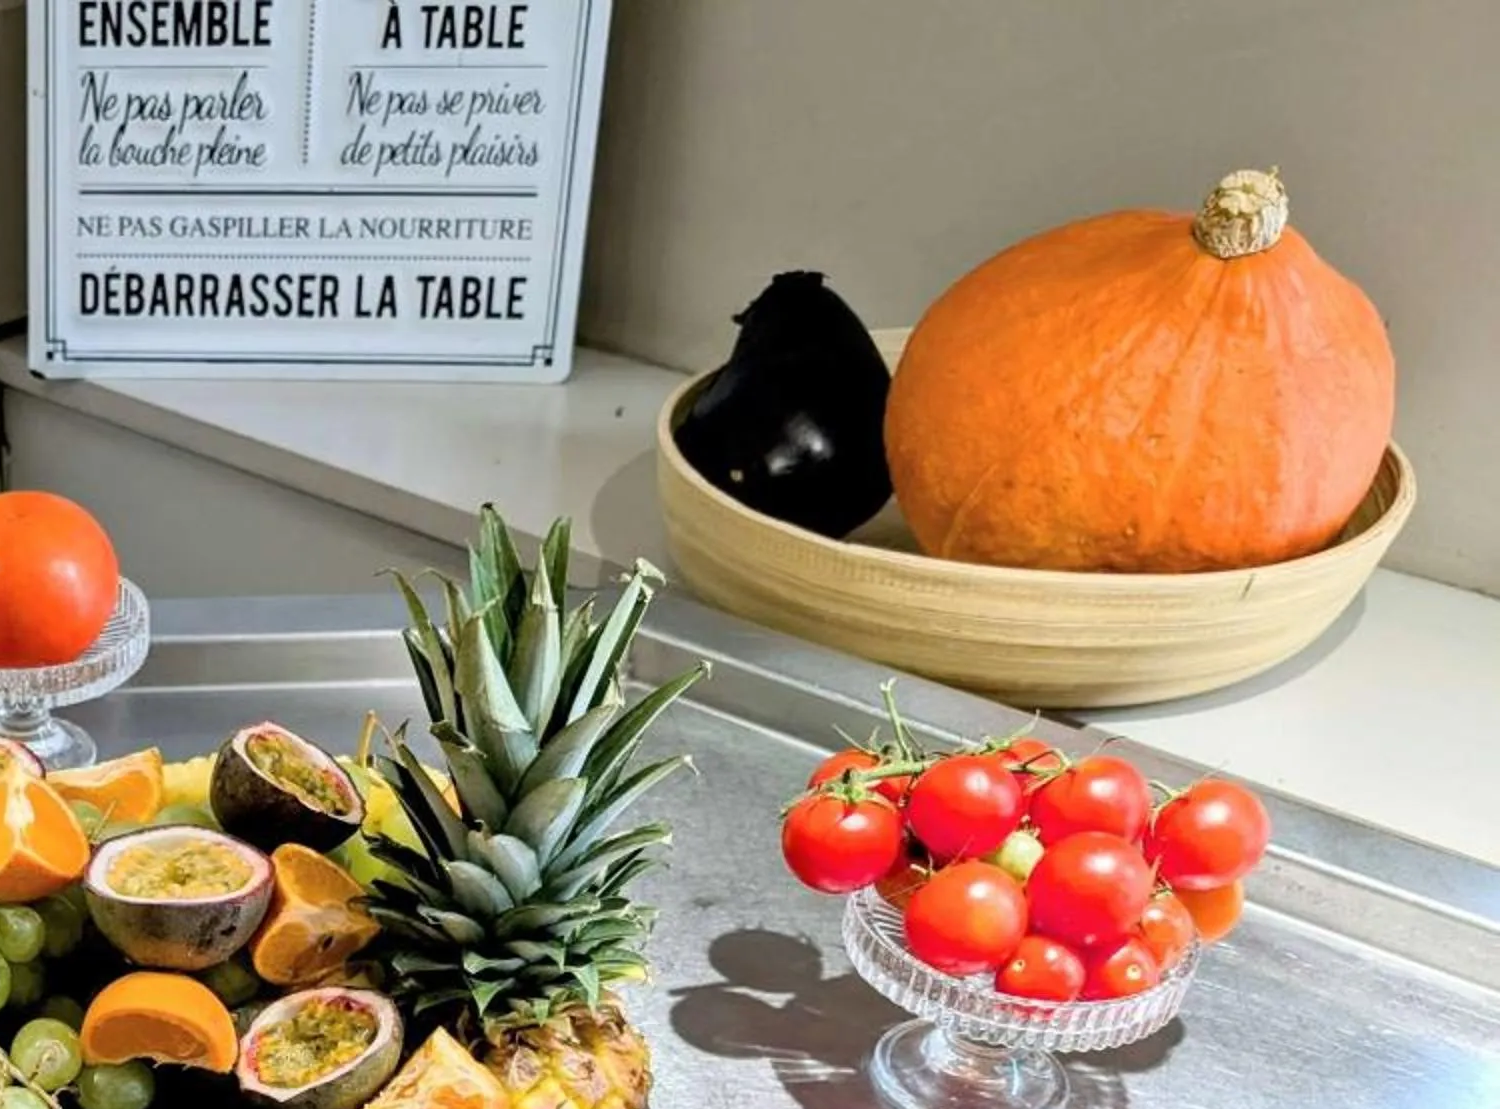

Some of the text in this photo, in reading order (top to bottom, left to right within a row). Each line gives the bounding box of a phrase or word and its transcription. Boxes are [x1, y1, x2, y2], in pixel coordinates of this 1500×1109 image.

[79, 1, 273, 47] ENSEMBLE
[420, 5, 529, 49] TABLE
[80, 70, 267, 134] Ne pas parler
[346, 71, 545, 127] Ne pas se priver
[79, 124, 266, 178] la bouche pleine
[340, 123, 539, 178] de petits plaisirs
[76, 216, 533, 241] NE PAS GASPILLER LA NOURRITURE
[80, 265, 528, 320] DÉBARRASSER LA TABLE
